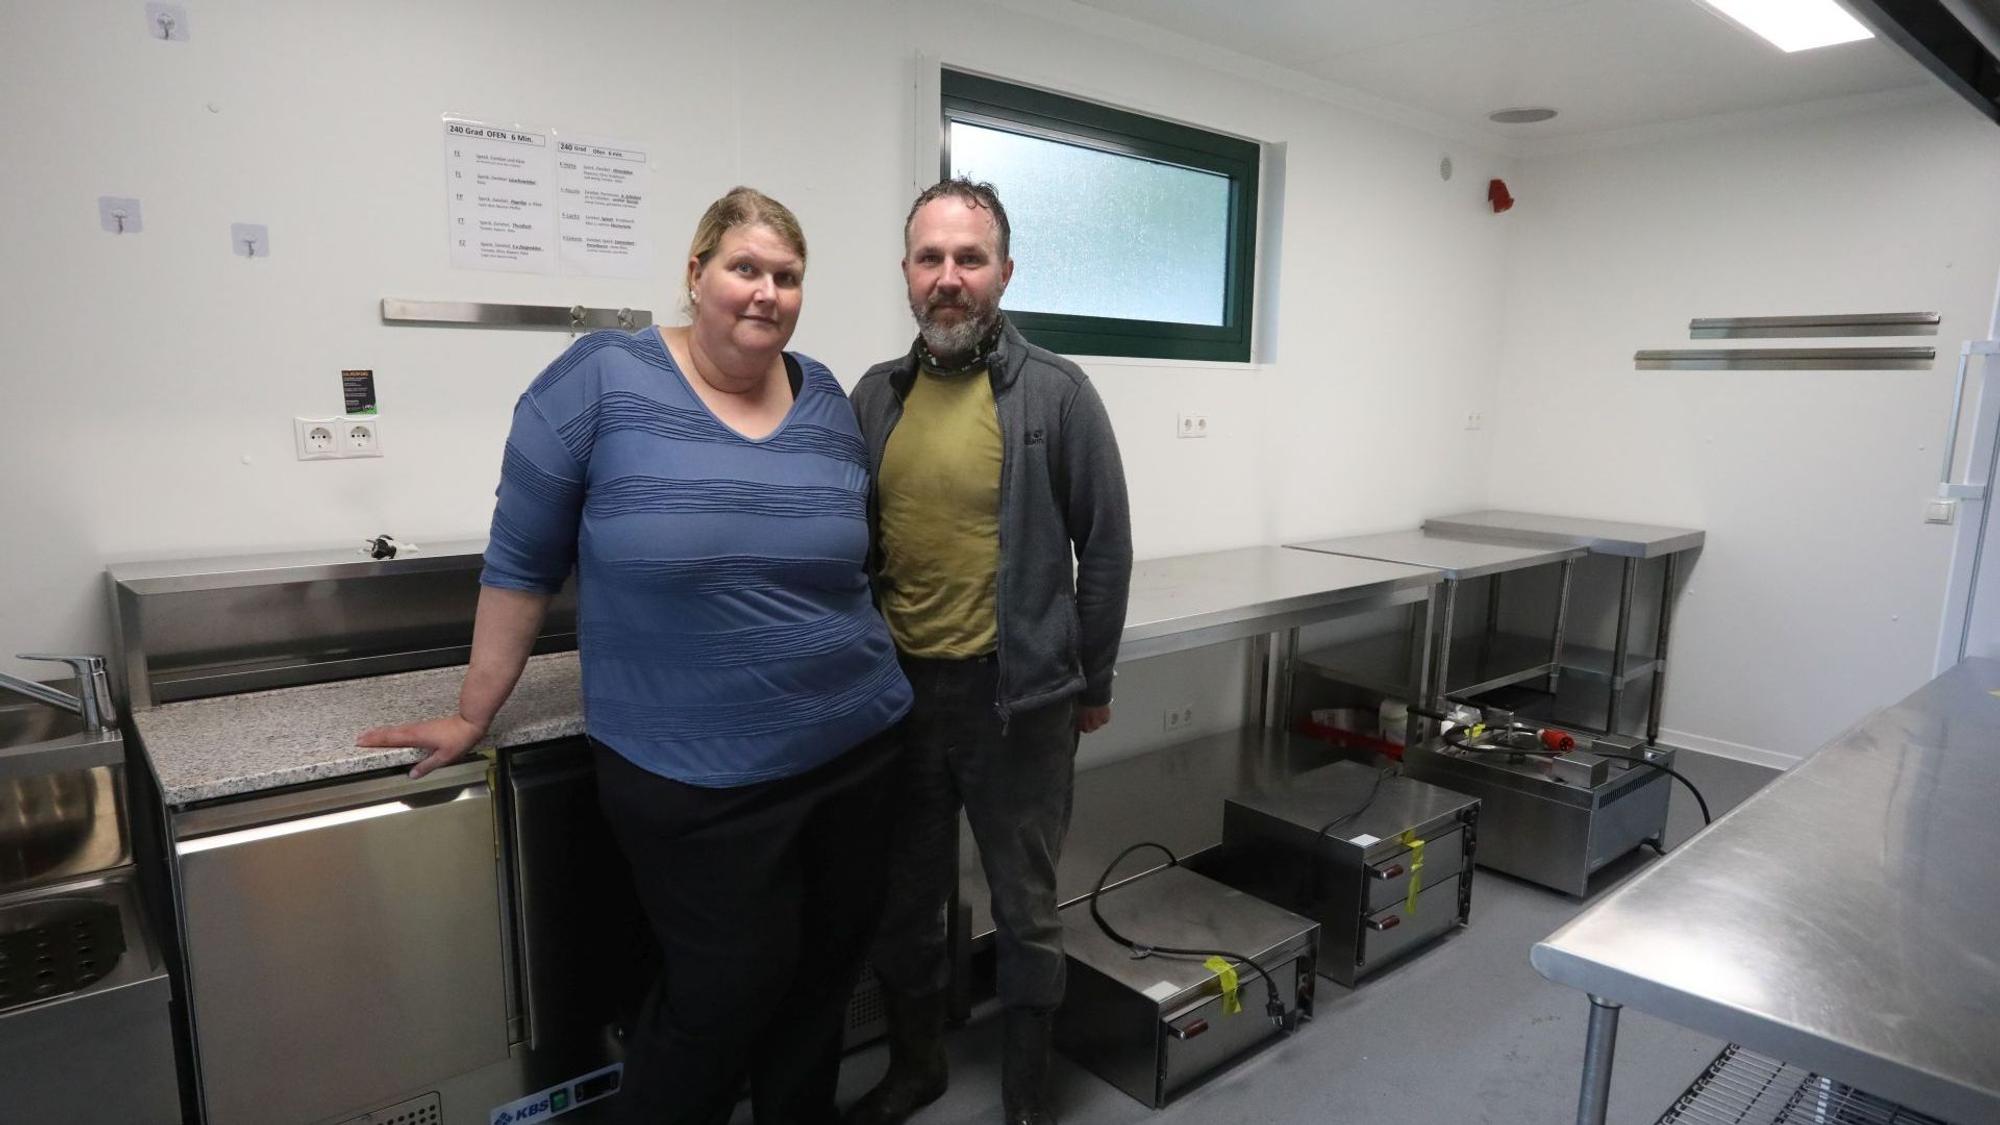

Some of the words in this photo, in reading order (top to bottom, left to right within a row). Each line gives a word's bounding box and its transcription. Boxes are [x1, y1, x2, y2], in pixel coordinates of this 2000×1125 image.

[450, 125, 463, 134] 240
[465, 127, 483, 136] Grad
[486, 130, 506, 139] OFEN
[560, 143, 573, 151] 240
[516, 1099, 550, 1121] KBS
